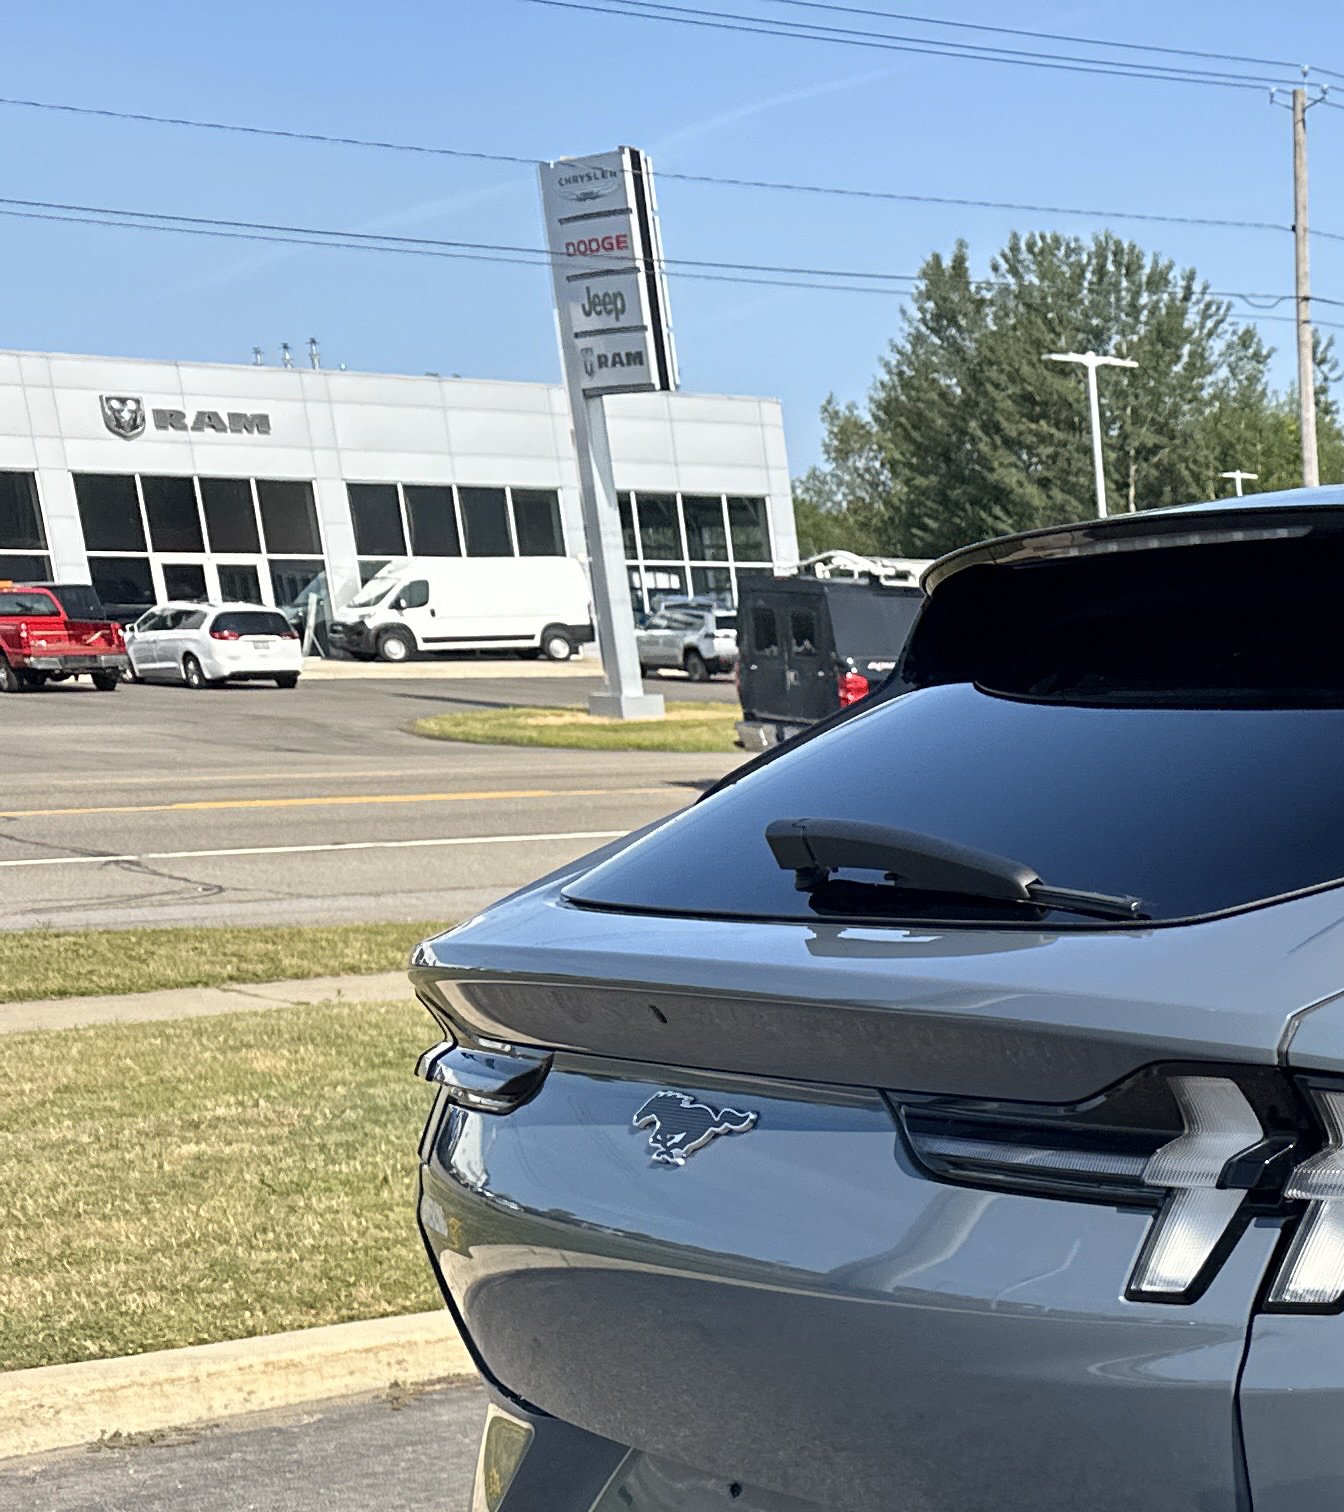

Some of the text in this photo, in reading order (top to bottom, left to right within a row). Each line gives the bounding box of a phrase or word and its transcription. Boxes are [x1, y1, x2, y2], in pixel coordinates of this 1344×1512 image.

[558, 170, 617, 186] CHRYSLER
[565, 234, 629, 256] DODGE
[581, 286, 626, 322] Jeep
[597, 350, 644, 370] RAM
[152, 408, 271, 435] RAM
